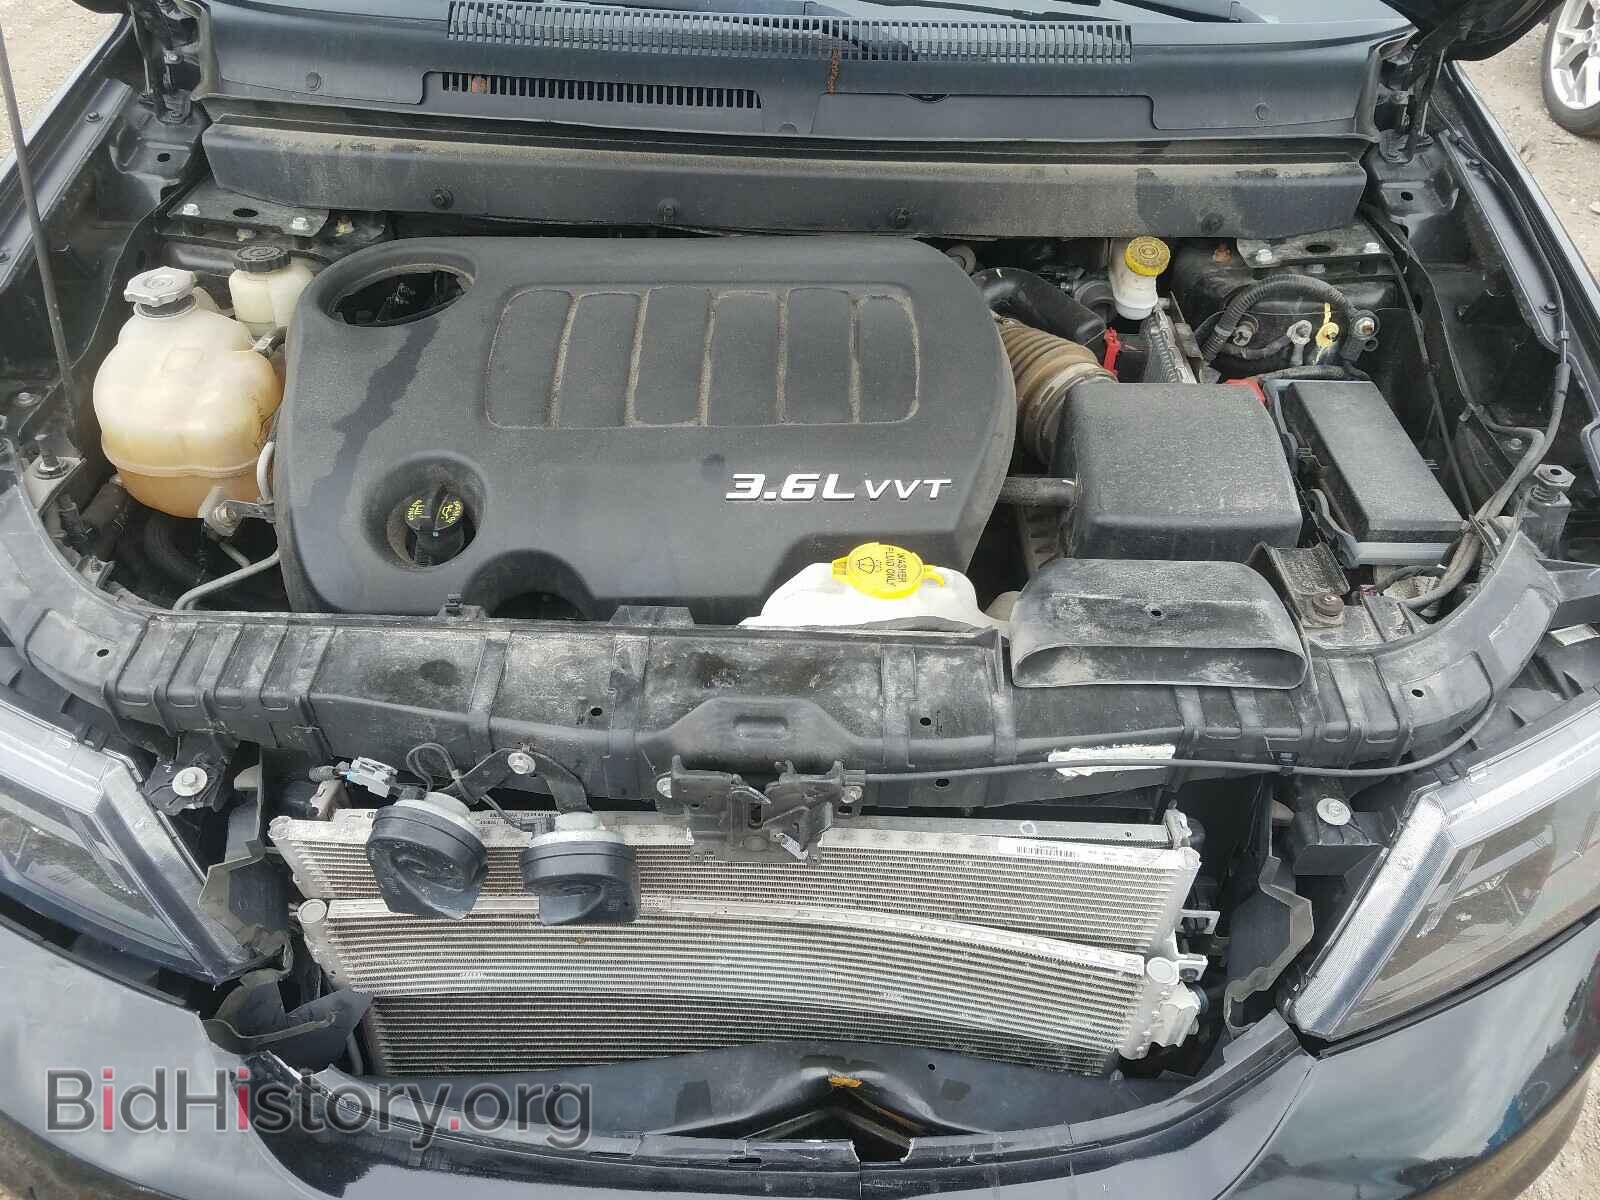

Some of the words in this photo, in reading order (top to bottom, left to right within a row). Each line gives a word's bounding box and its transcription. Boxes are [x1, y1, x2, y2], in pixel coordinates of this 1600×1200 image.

[726, 473, 856, 501] 3.6L
[864, 478, 953, 501] VVT
[886, 568, 896, 587] ONLY
[897, 552, 908, 583] WASHER
